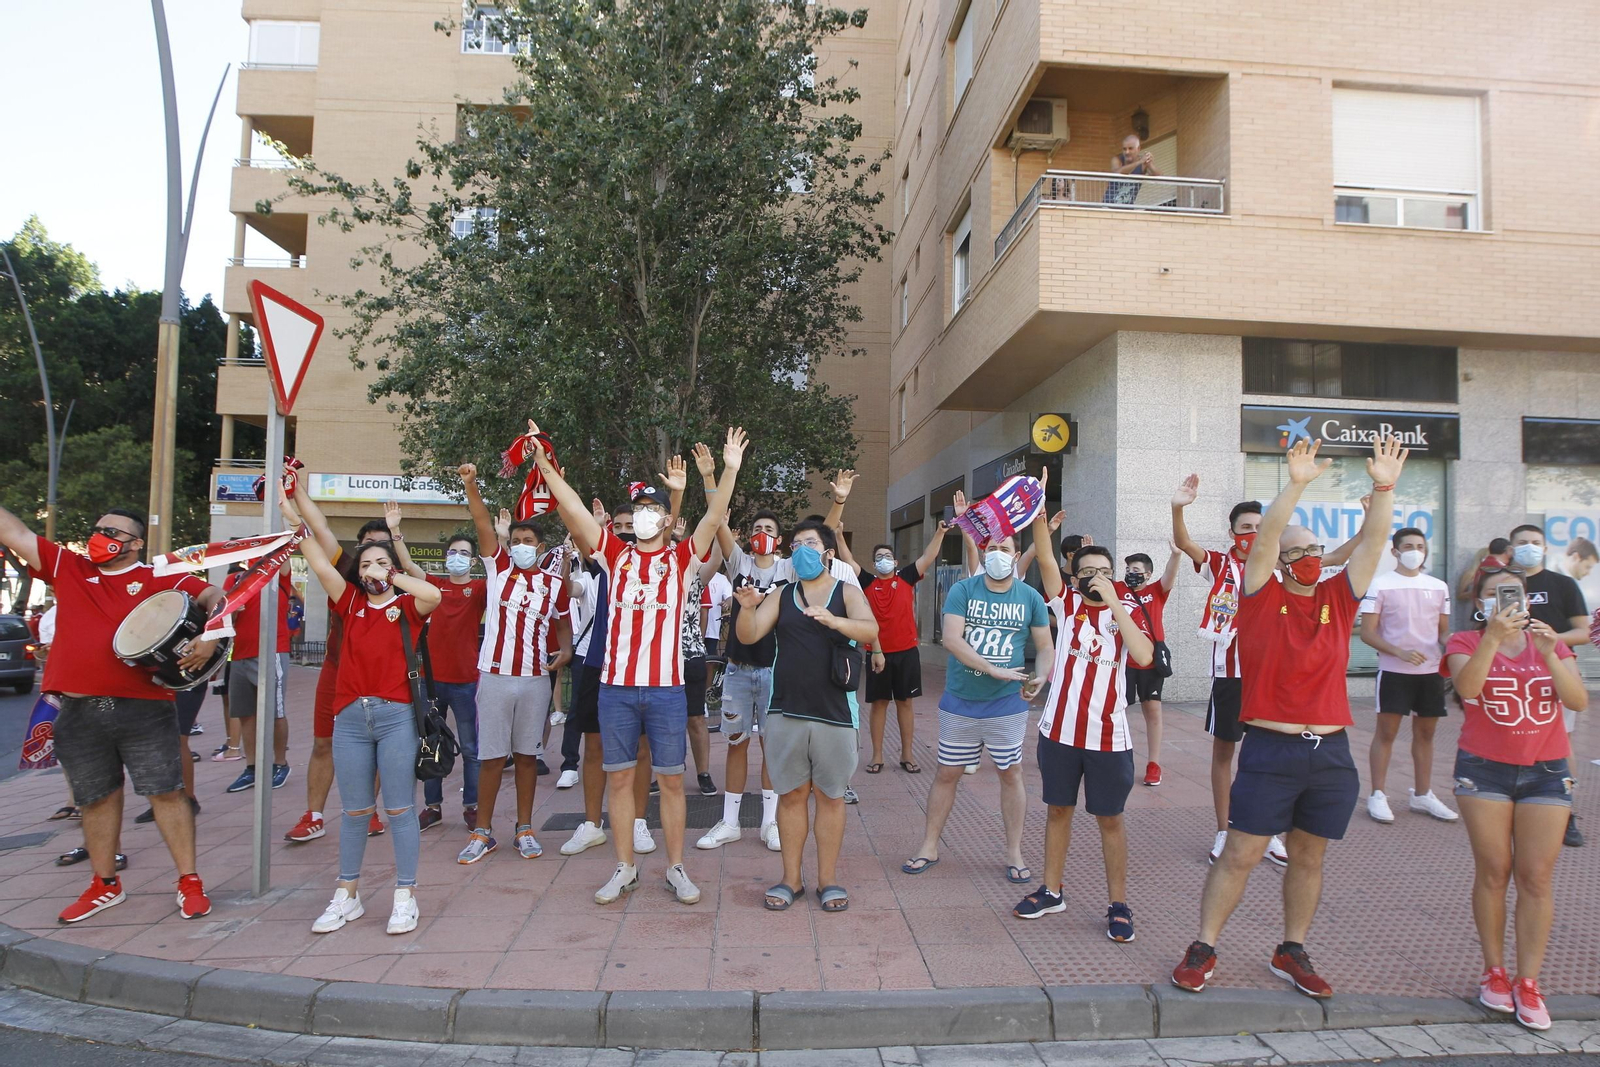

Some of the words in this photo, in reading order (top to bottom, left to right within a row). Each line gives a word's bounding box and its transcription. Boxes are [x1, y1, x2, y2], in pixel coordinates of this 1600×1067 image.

[1321, 419, 1429, 446] CaixaBank
[410, 546, 443, 557] Bankia
[967, 598, 1025, 622] HELSINKI
[1480, 675, 1558, 727] 58
